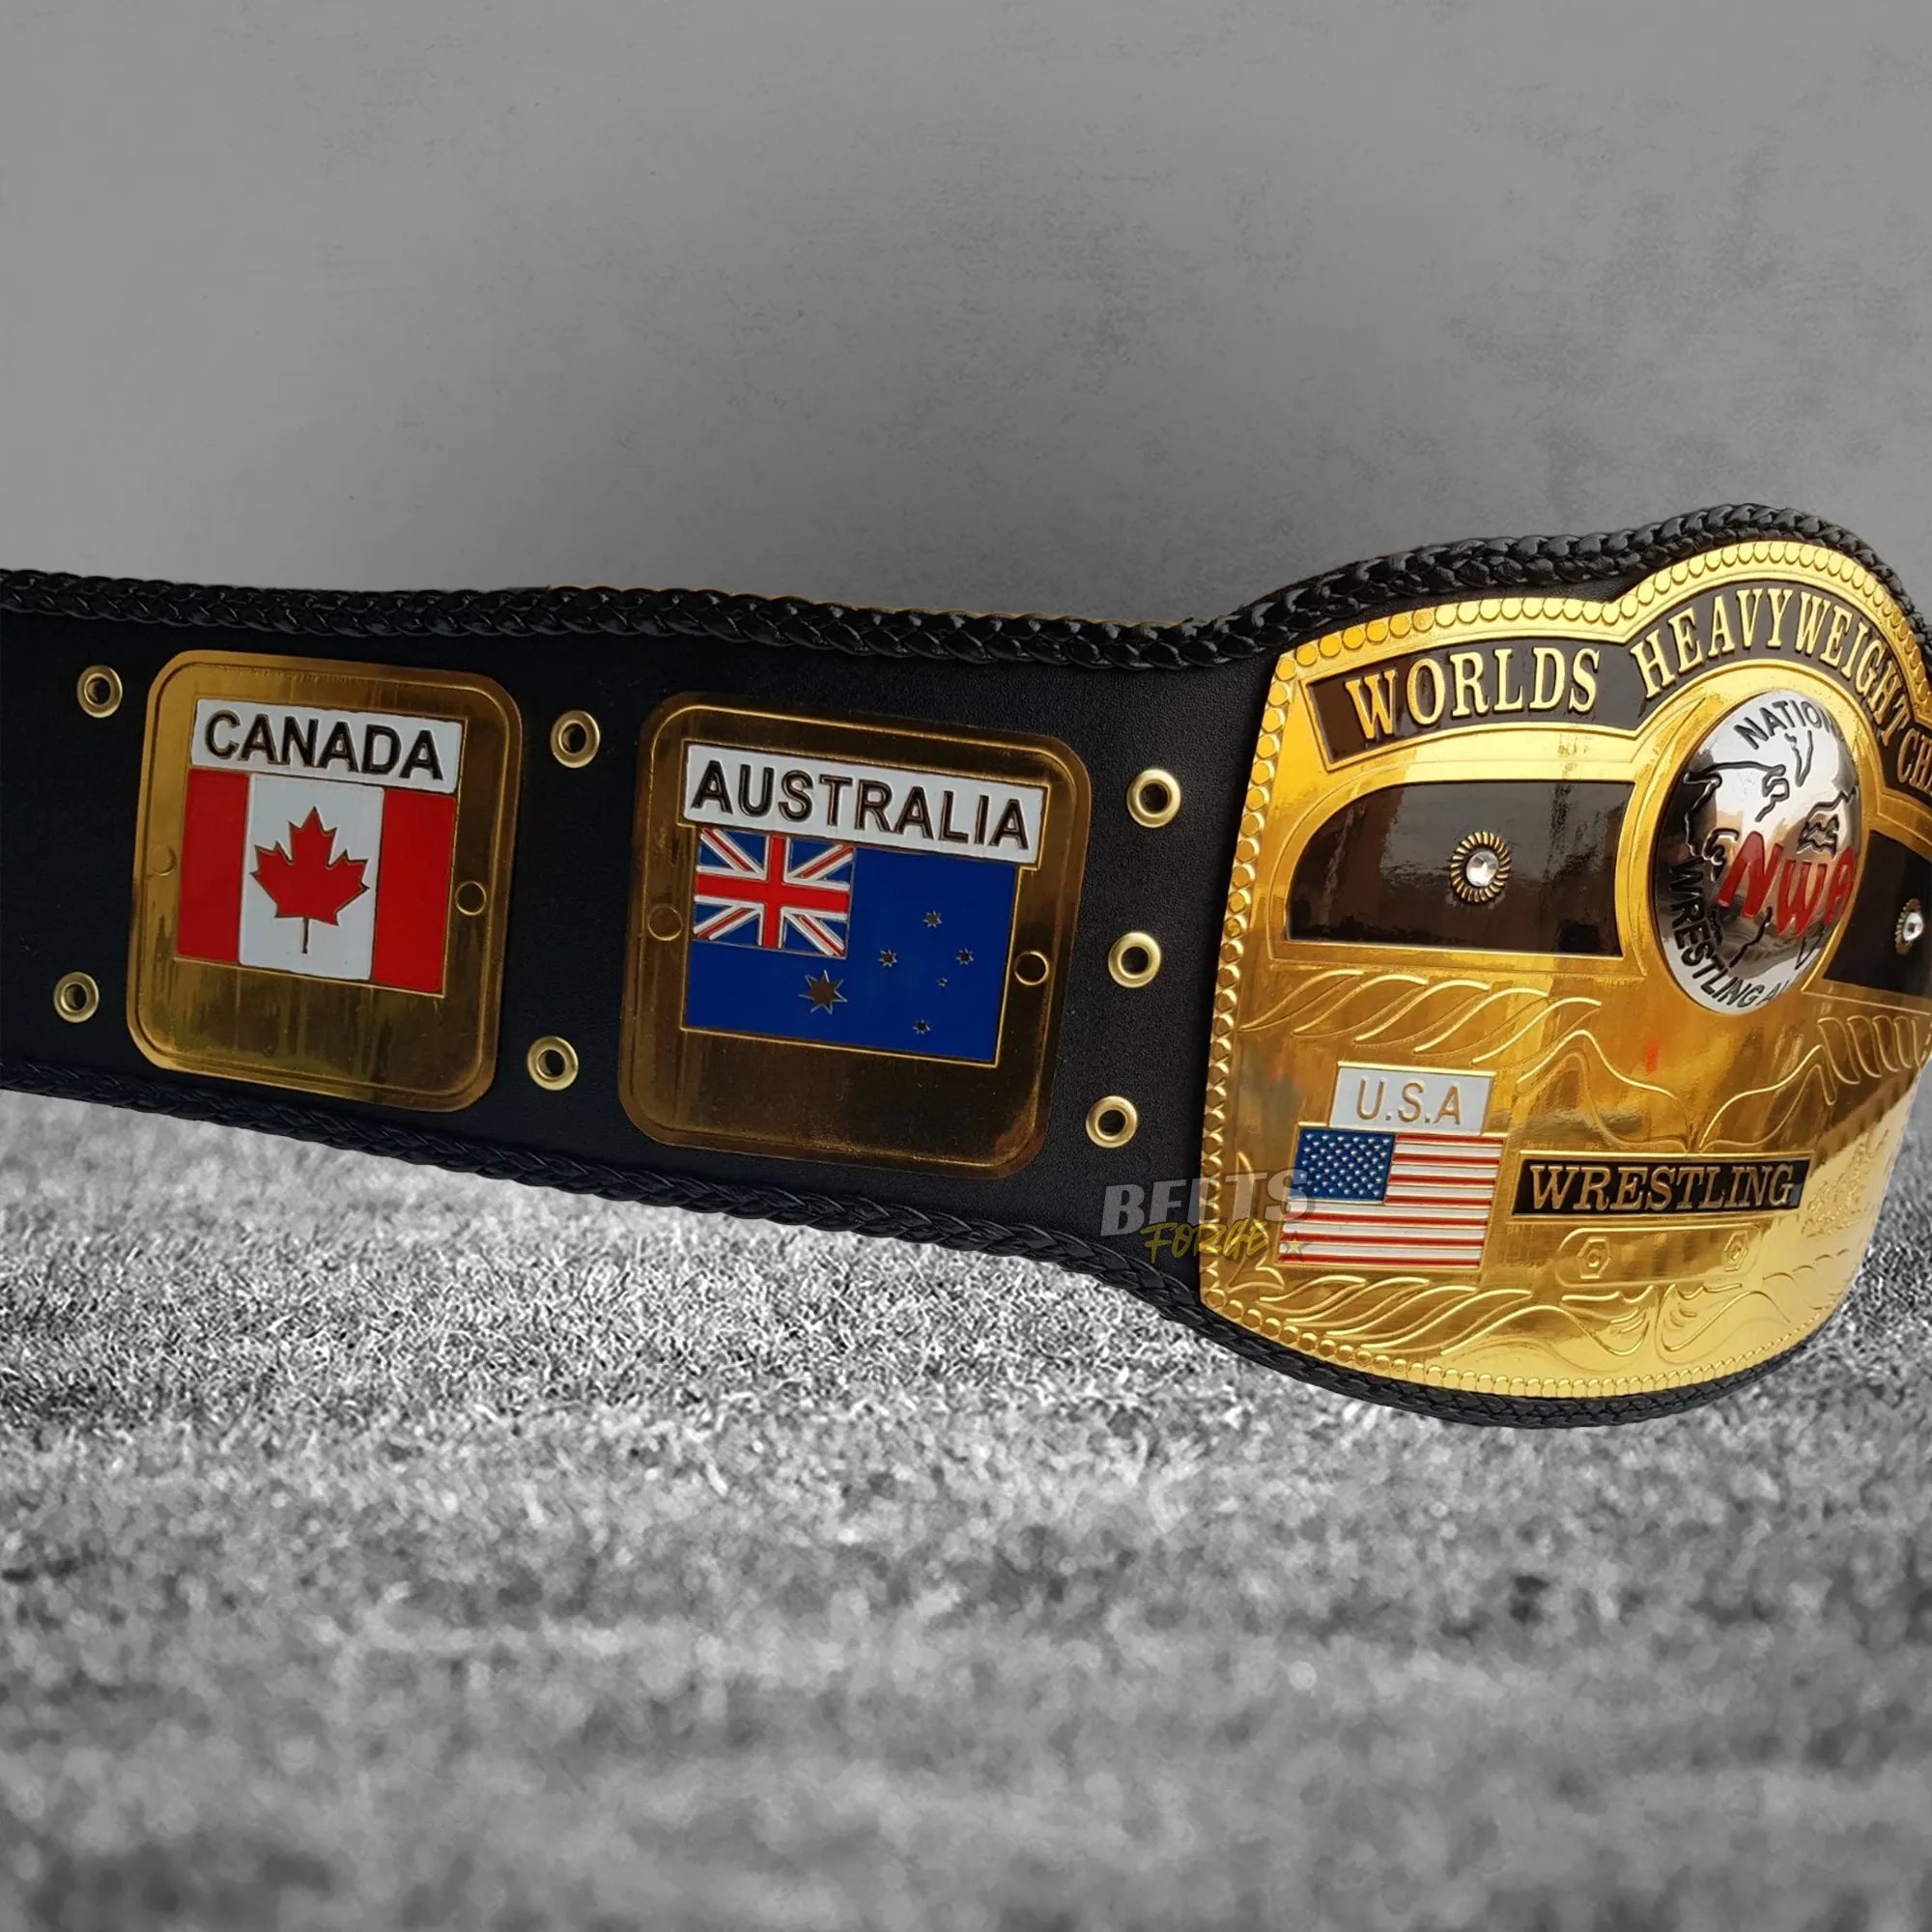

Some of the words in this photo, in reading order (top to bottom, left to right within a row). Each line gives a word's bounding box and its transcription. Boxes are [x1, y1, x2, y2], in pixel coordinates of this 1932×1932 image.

[1345, 646, 1600, 740] WORLDS
[1629, 587, 1911, 747] HEAVYWEIGHT
[204, 709, 443, 781] CANADA
[690, 759, 1030, 851] AUSTRALIA
[1716, 830, 1856, 939] NWA
[1669, 856, 1766, 1008] WRESTLING
[1355, 1076, 1462, 1126] U.S.A
[1527, 1163, 1794, 1211] WRESTLING
